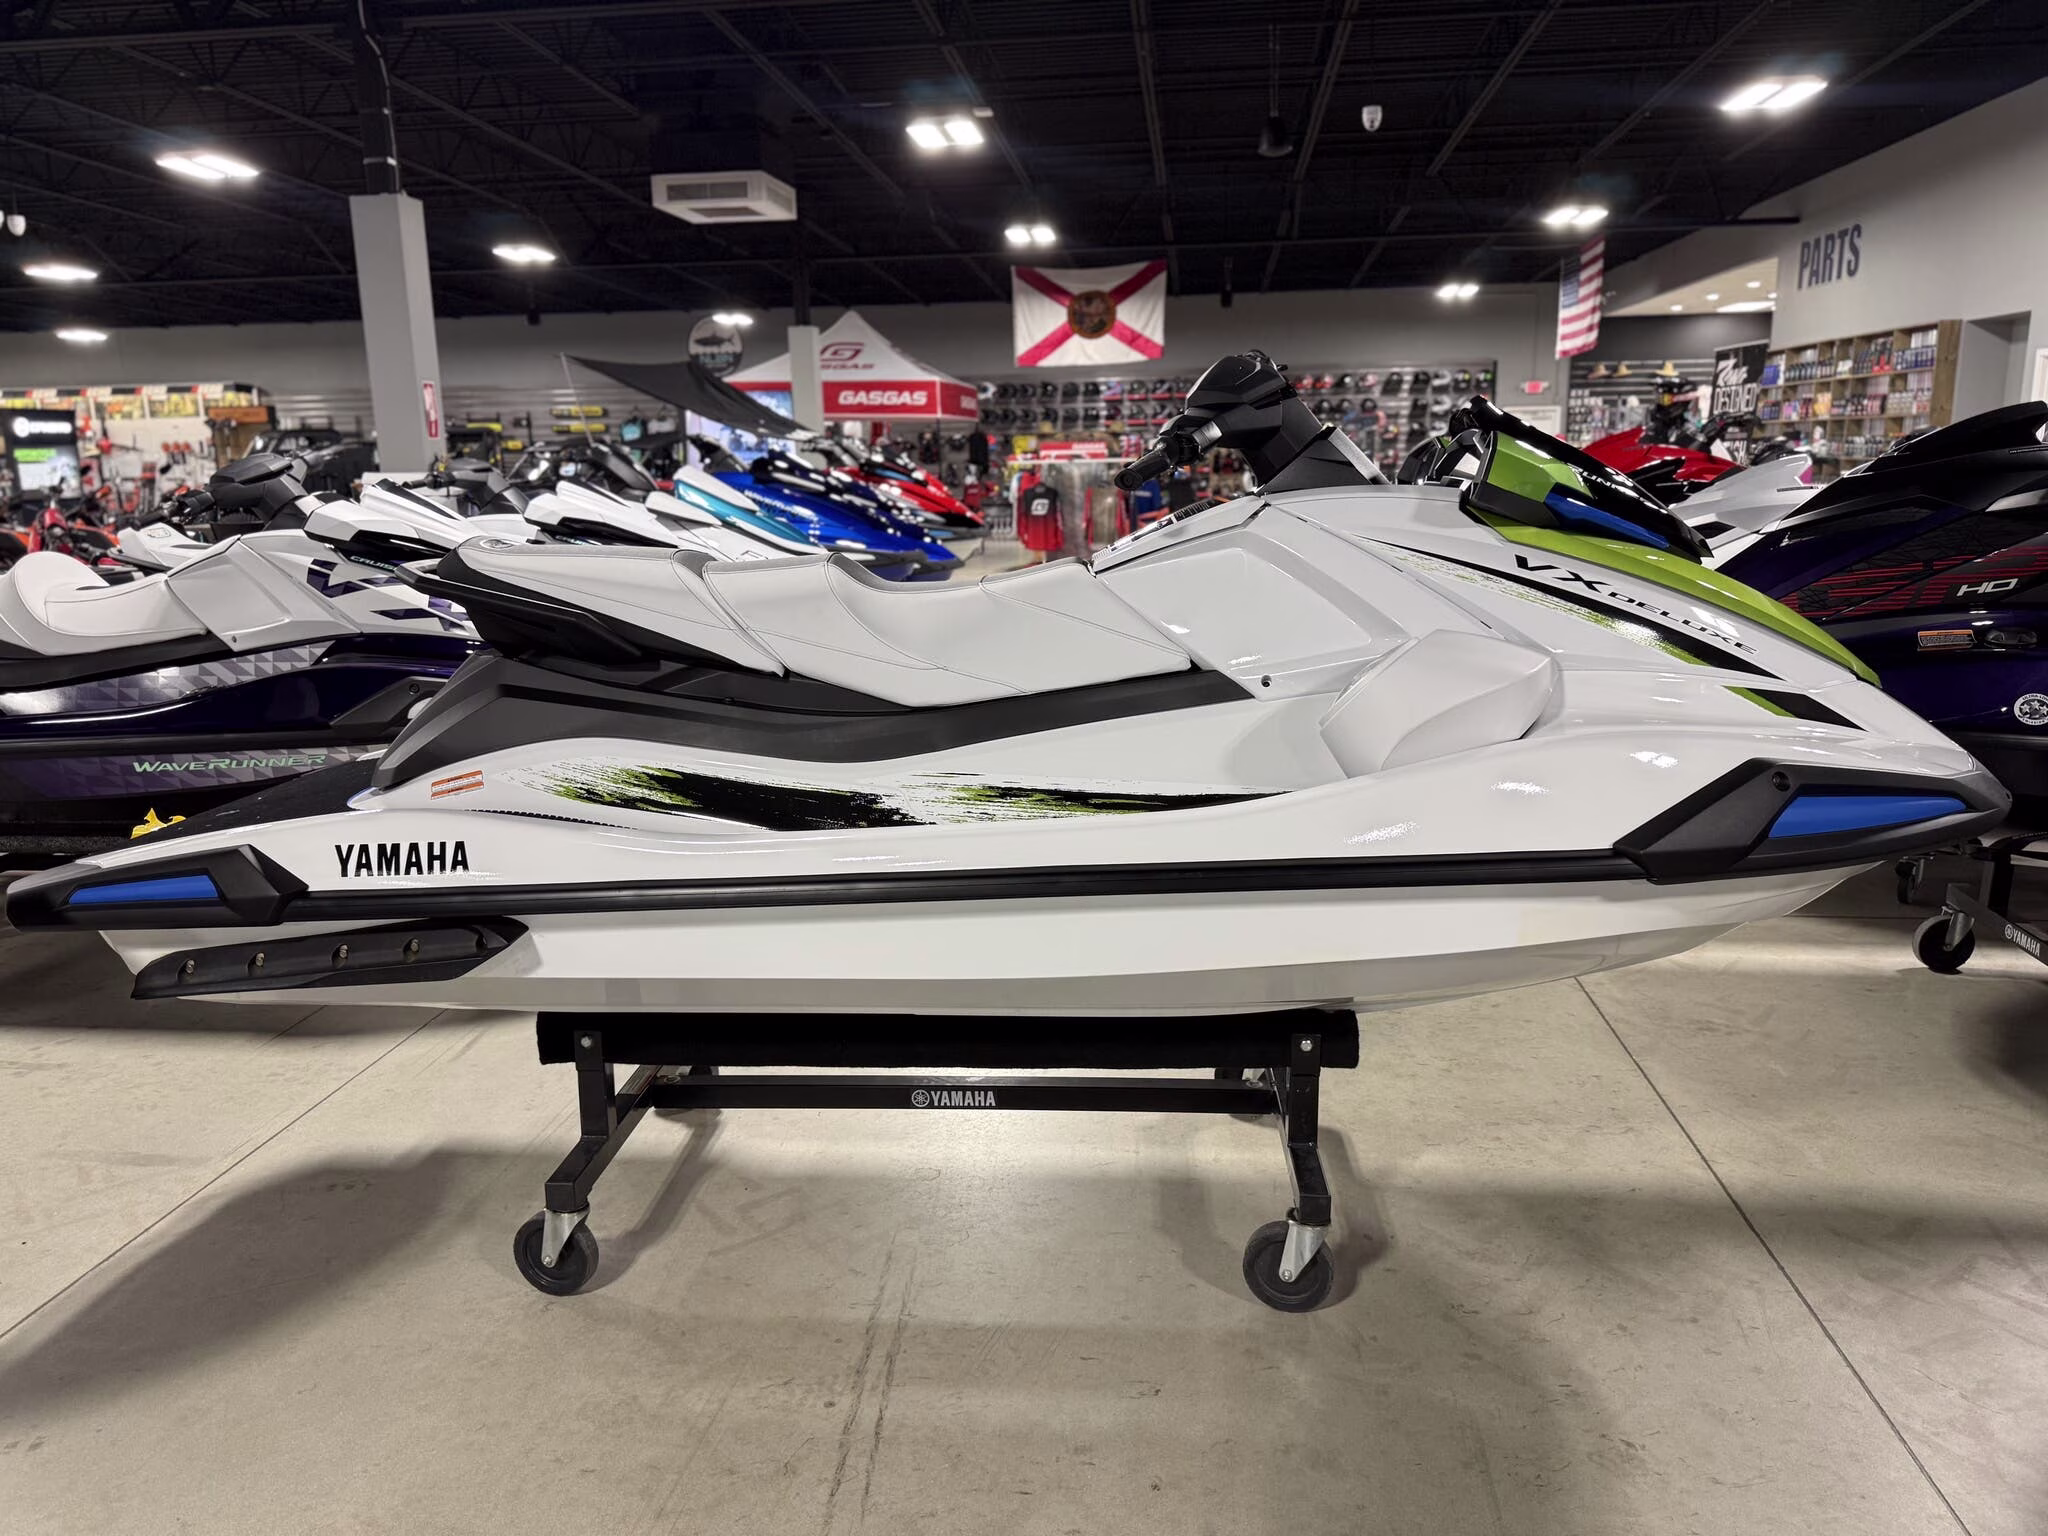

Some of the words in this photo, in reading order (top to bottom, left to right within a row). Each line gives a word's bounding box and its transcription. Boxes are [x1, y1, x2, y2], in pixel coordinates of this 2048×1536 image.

[1797, 223, 1862, 291] PARTS
[838, 390, 928, 406] GASGAS
[350, 555, 398, 572] CRUIS
[1514, 553, 1612, 593] VX
[1607, 591, 1757, 655] DELUXE
[133, 754, 327, 773] WAVERUNNER
[335, 841, 469, 877] YAMAHA
[2013, 928, 2041, 957] YAMAHA
[931, 1090, 996, 1107] YAMAHA
